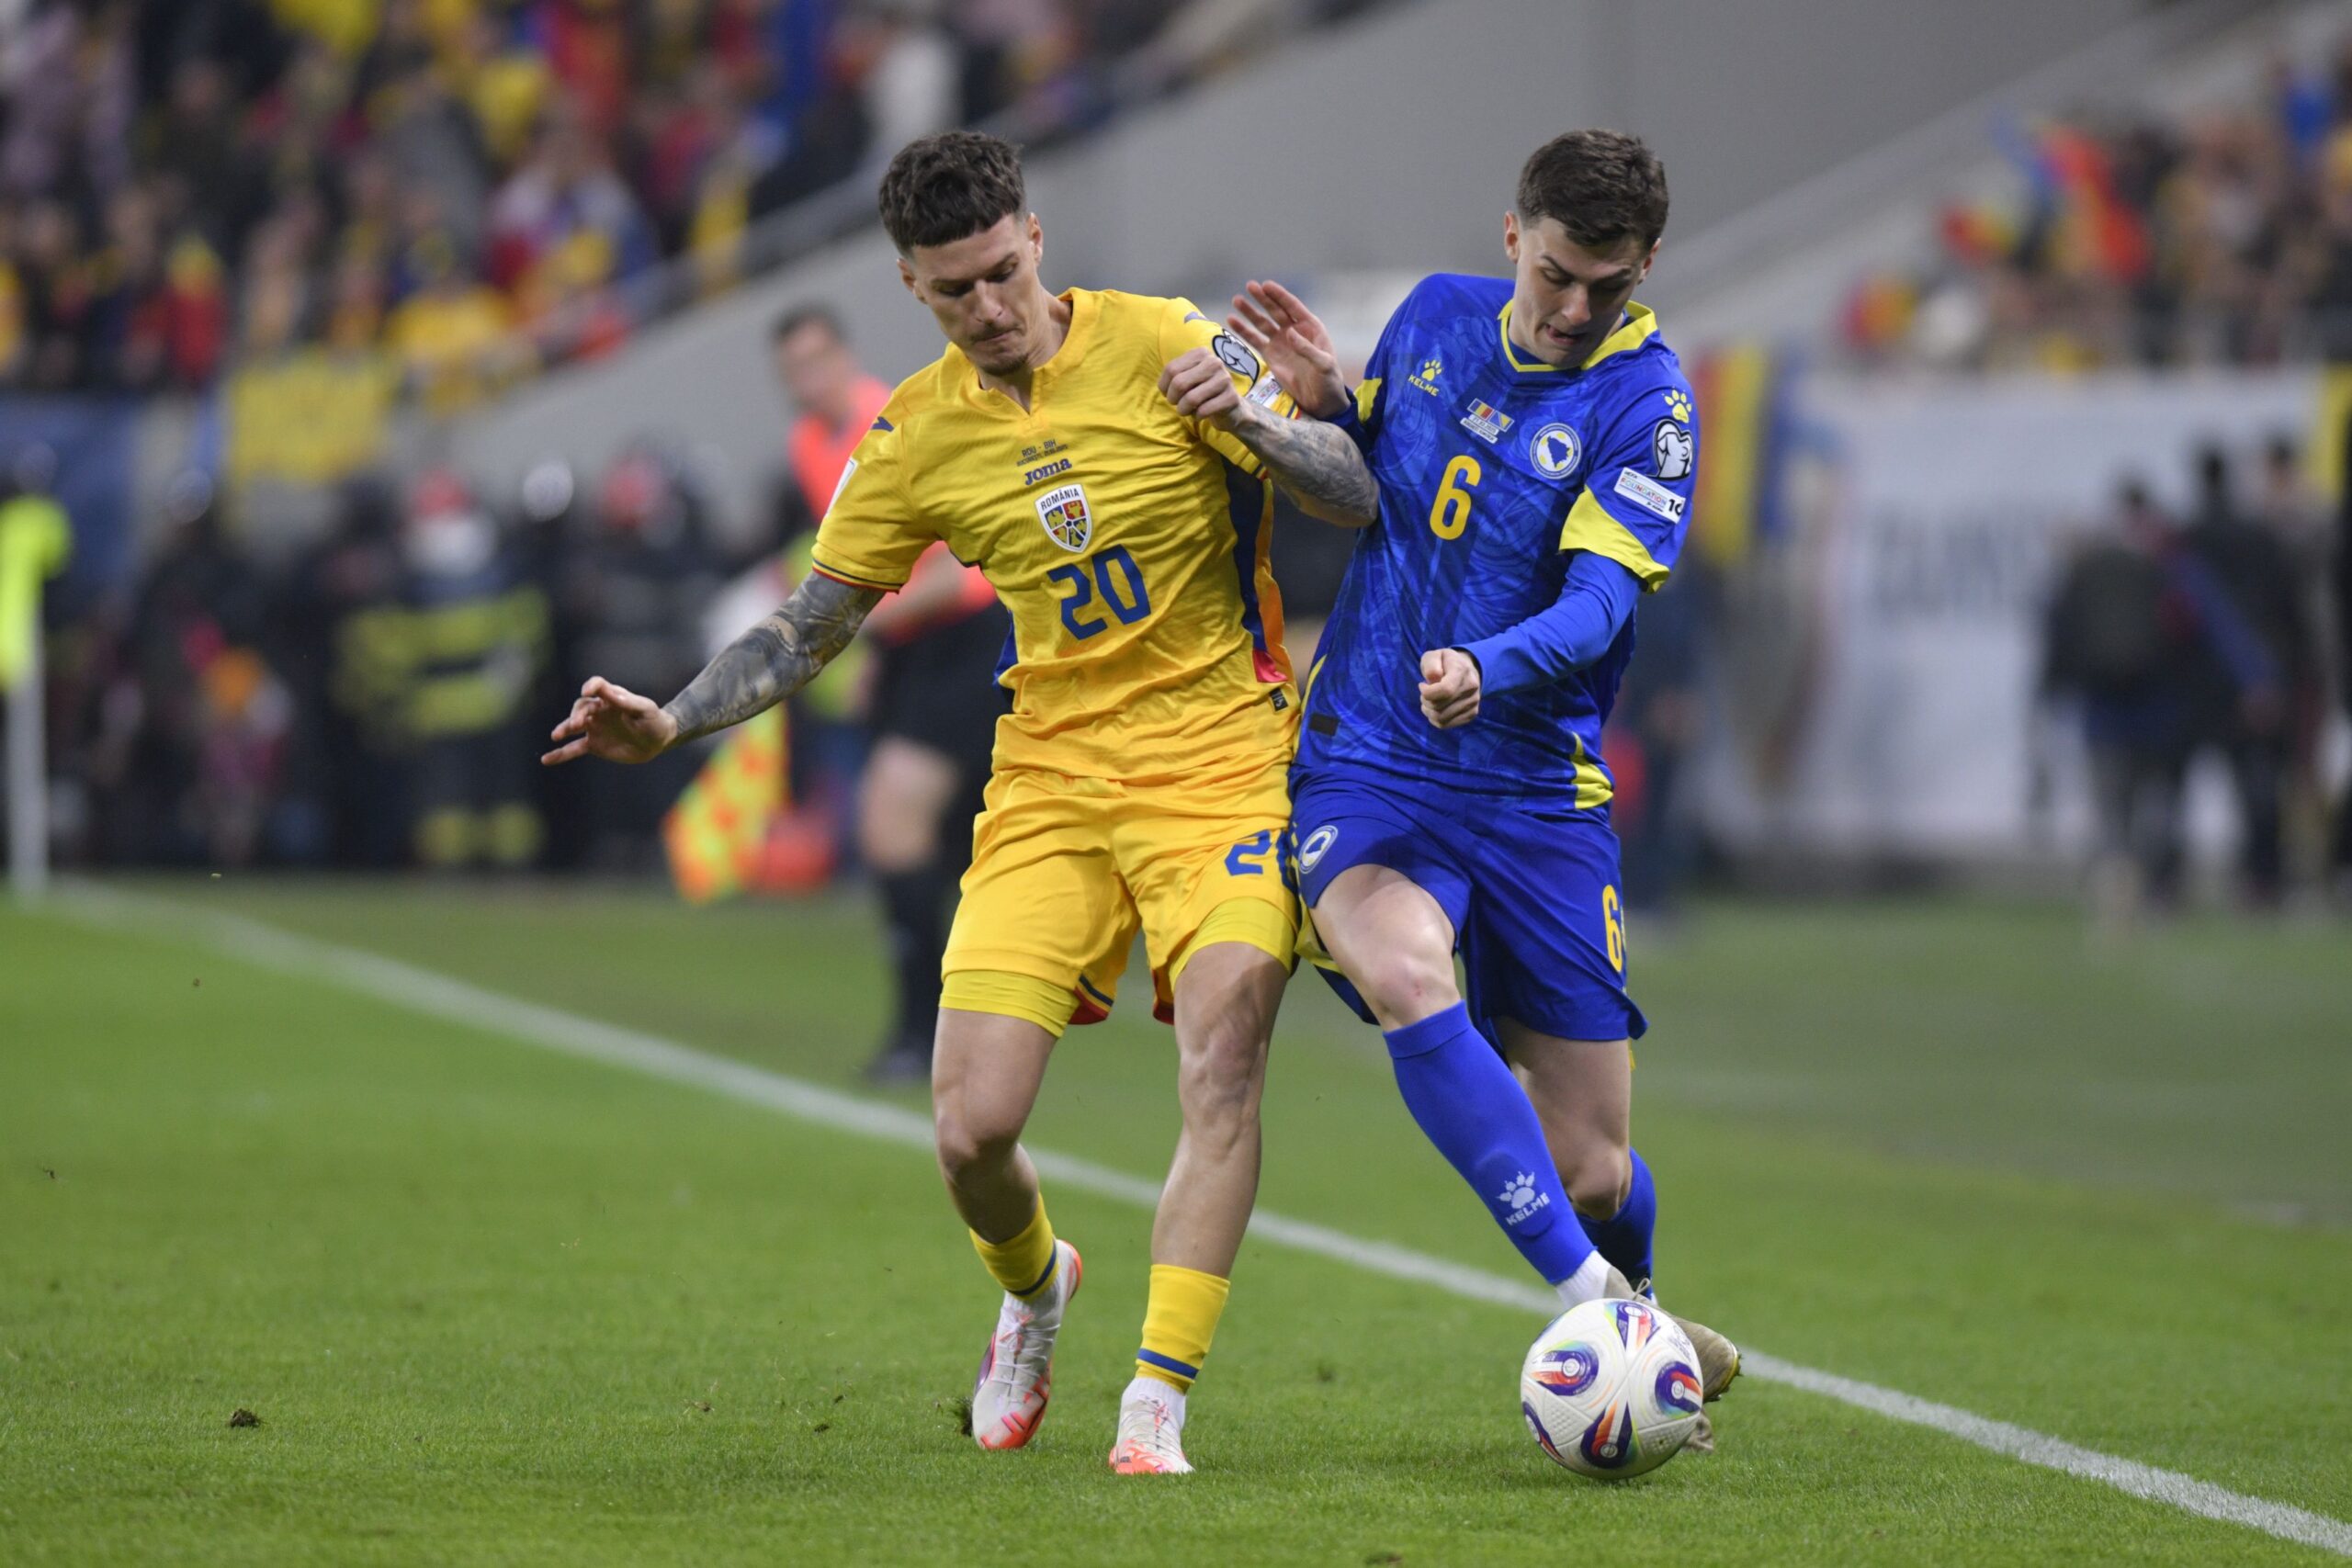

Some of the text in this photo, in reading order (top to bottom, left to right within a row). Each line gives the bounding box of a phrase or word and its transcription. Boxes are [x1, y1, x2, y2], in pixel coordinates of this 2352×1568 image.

[1408, 374, 1440, 397] KELME
[1040, 488, 1080, 511] ROMÂNIA
[1430, 455, 1481, 540] 6
[1620, 477, 1668, 506] FOUNDATION
[1046, 544, 1151, 640] 20
[1602, 885, 1623, 972] 6
[1505, 1192, 1550, 1225] KELME
